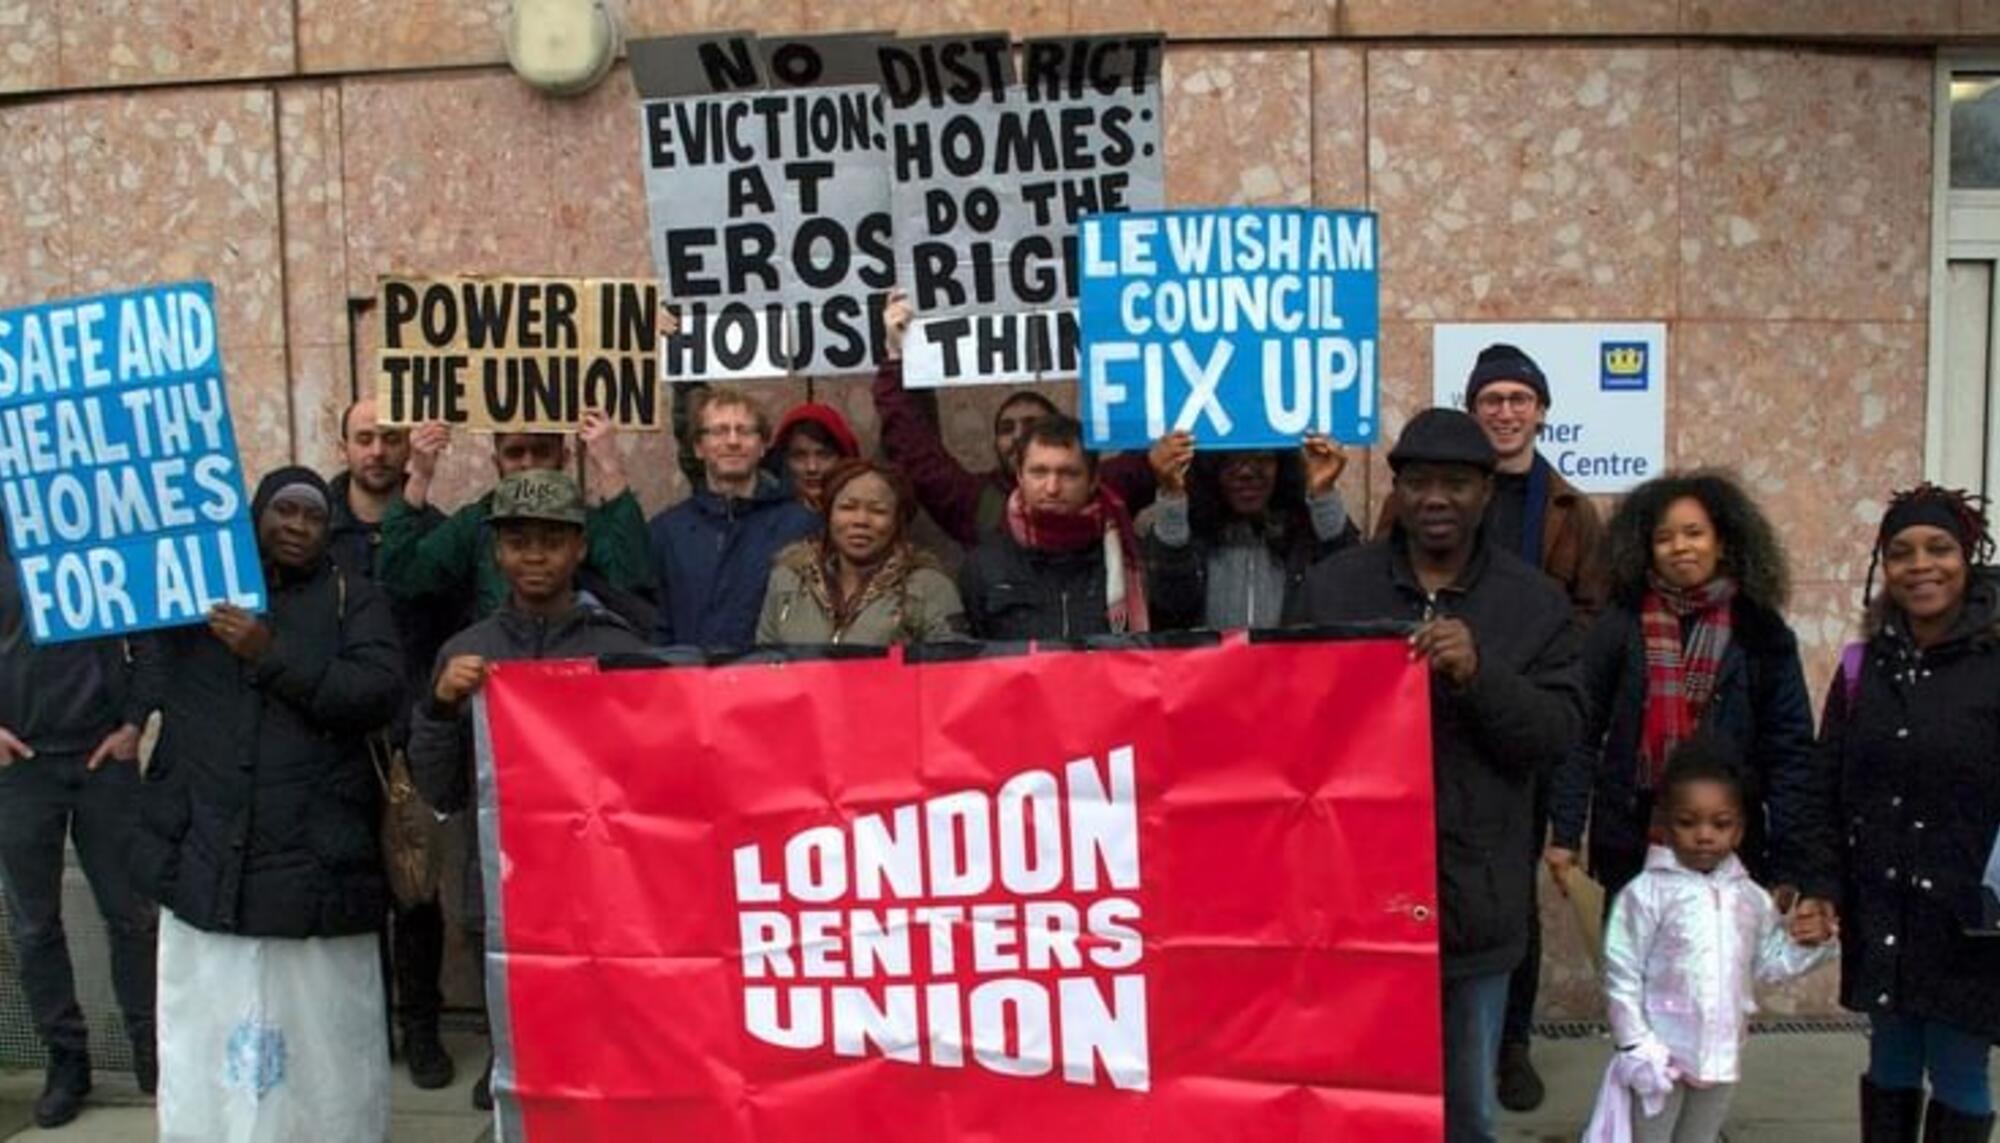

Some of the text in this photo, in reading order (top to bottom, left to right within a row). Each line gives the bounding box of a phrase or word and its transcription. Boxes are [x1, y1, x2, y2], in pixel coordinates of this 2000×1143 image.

[700, 37, 823, 91] NO
[877, 36, 1160, 109] DISTRICT
[895, 106, 1154, 182] HOMES:
[728, 161, 834, 218] AT
[926, 172, 1131, 235] DO THE
[667, 212, 895, 297] EROS
[912, 235, 1079, 311] RIG
[1084, 216, 1373, 278] LEWISHAM
[384, 282, 657, 352] POWER IN
[1121, 275, 1342, 335] COUNCIL
[0, 291, 214, 398] SAFE AND
[925, 310, 1081, 378] THIN
[383, 355, 656, 425] THE UNION
[1090, 337, 1374, 441] FIX UP!
[0, 378, 223, 478] HEALTHY
[1558, 450, 1647, 477] Centre
[4, 454, 239, 549] HOMES
[21, 529, 259, 638] FOR ALL
[733, 745, 1141, 903] LONDON
[738, 898, 1143, 979] RENTERS
[744, 974, 1151, 1092] UNION
